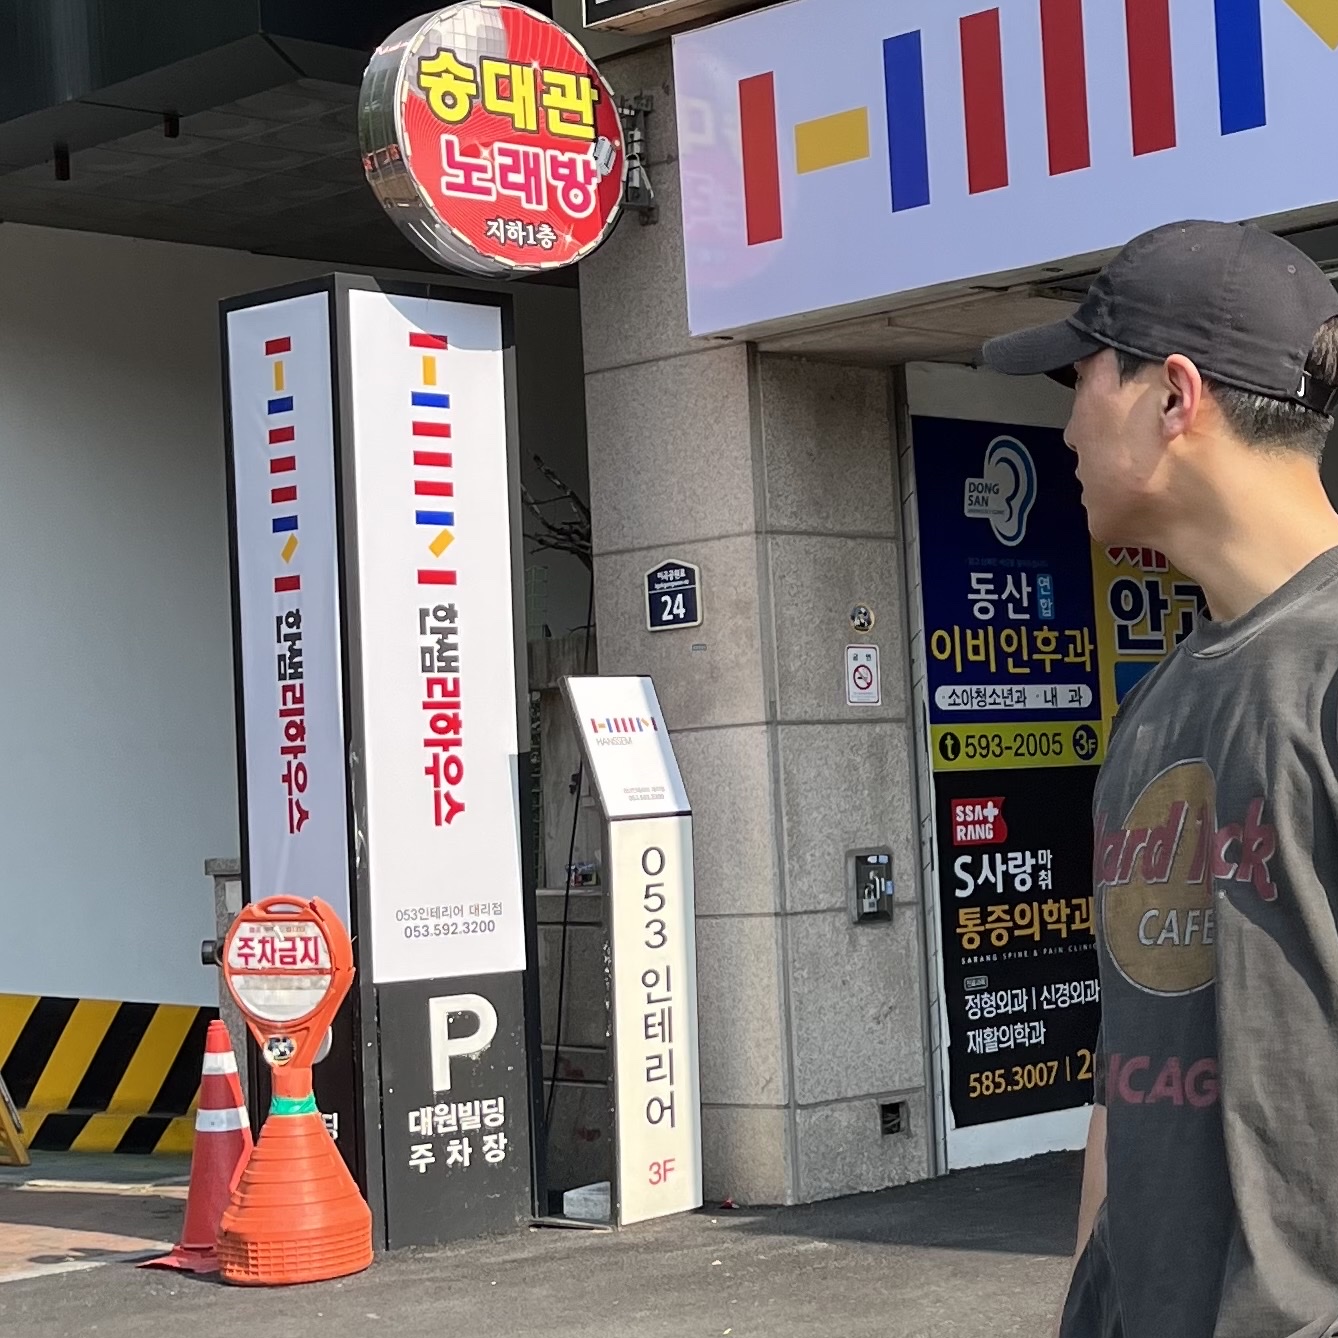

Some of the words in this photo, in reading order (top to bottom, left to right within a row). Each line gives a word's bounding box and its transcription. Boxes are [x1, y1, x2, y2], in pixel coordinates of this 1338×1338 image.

[418, 50, 598, 139] 송대관
[440, 134, 601, 218] 노래방
[486, 218, 556, 248] 지하1층
[967, 482, 1000, 495] DONG
[967, 494, 989, 507] SAN
[661, 593, 686, 621] 24
[967, 571, 1032, 620] 동산
[930, 624, 1095, 674] 이비인후과
[418, 602, 466, 827] 한샘리하우스
[948, 686, 1028, 709] 소아청소년과
[276, 608, 310, 834] 한샘리하우스
[965, 732, 1064, 759] 593-2005
[1074, 728, 1098, 757] 3F
[956, 823, 995, 842] RANG
[953, 850, 1037, 898] S사랑
[396, 905, 465, 922] 053인테리어
[468, 902, 503, 917] 대리점
[404, 919, 496, 939] 053.592.3200
[955, 895, 1095, 950] 통증의학과
[1138, 908, 1216, 946] CAFE
[237, 935, 320, 966] 주차금지
[964, 987, 1028, 1020] 정형외과
[1040, 978, 1100, 1011] 신경외과
[429, 993, 498, 1092] P
[641, 964, 675, 1129] 인테리어
[966, 1020, 1047, 1054] 재활의학과
[968, 1060, 1059, 1099] 585.3007
[1075, 1047, 1096, 1081] 2
[408, 1096, 505, 1136] 대원빌딩
[648, 1158, 676, 1186] 3F
